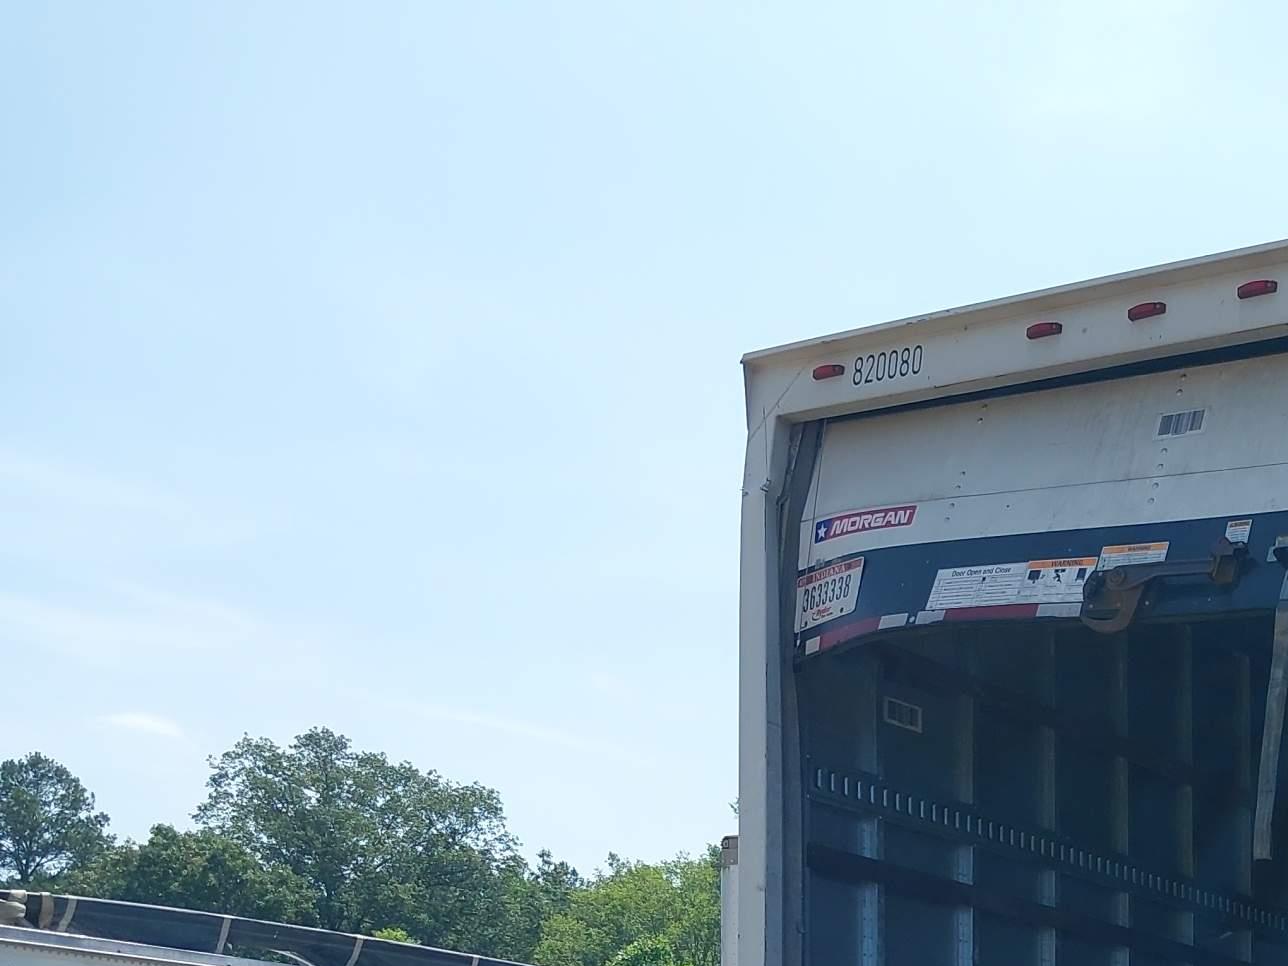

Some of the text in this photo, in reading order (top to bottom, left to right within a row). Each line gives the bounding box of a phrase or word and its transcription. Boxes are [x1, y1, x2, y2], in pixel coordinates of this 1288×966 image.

[852, 345, 923, 386] 820080
[830, 508, 911, 536] MORGAN
[813, 564, 846, 582] INDIANA
[951, 567, 1011, 578] Door Open and Close
[1050, 559, 1084, 567] WARNING
[803, 574, 852, 613] 3633338
